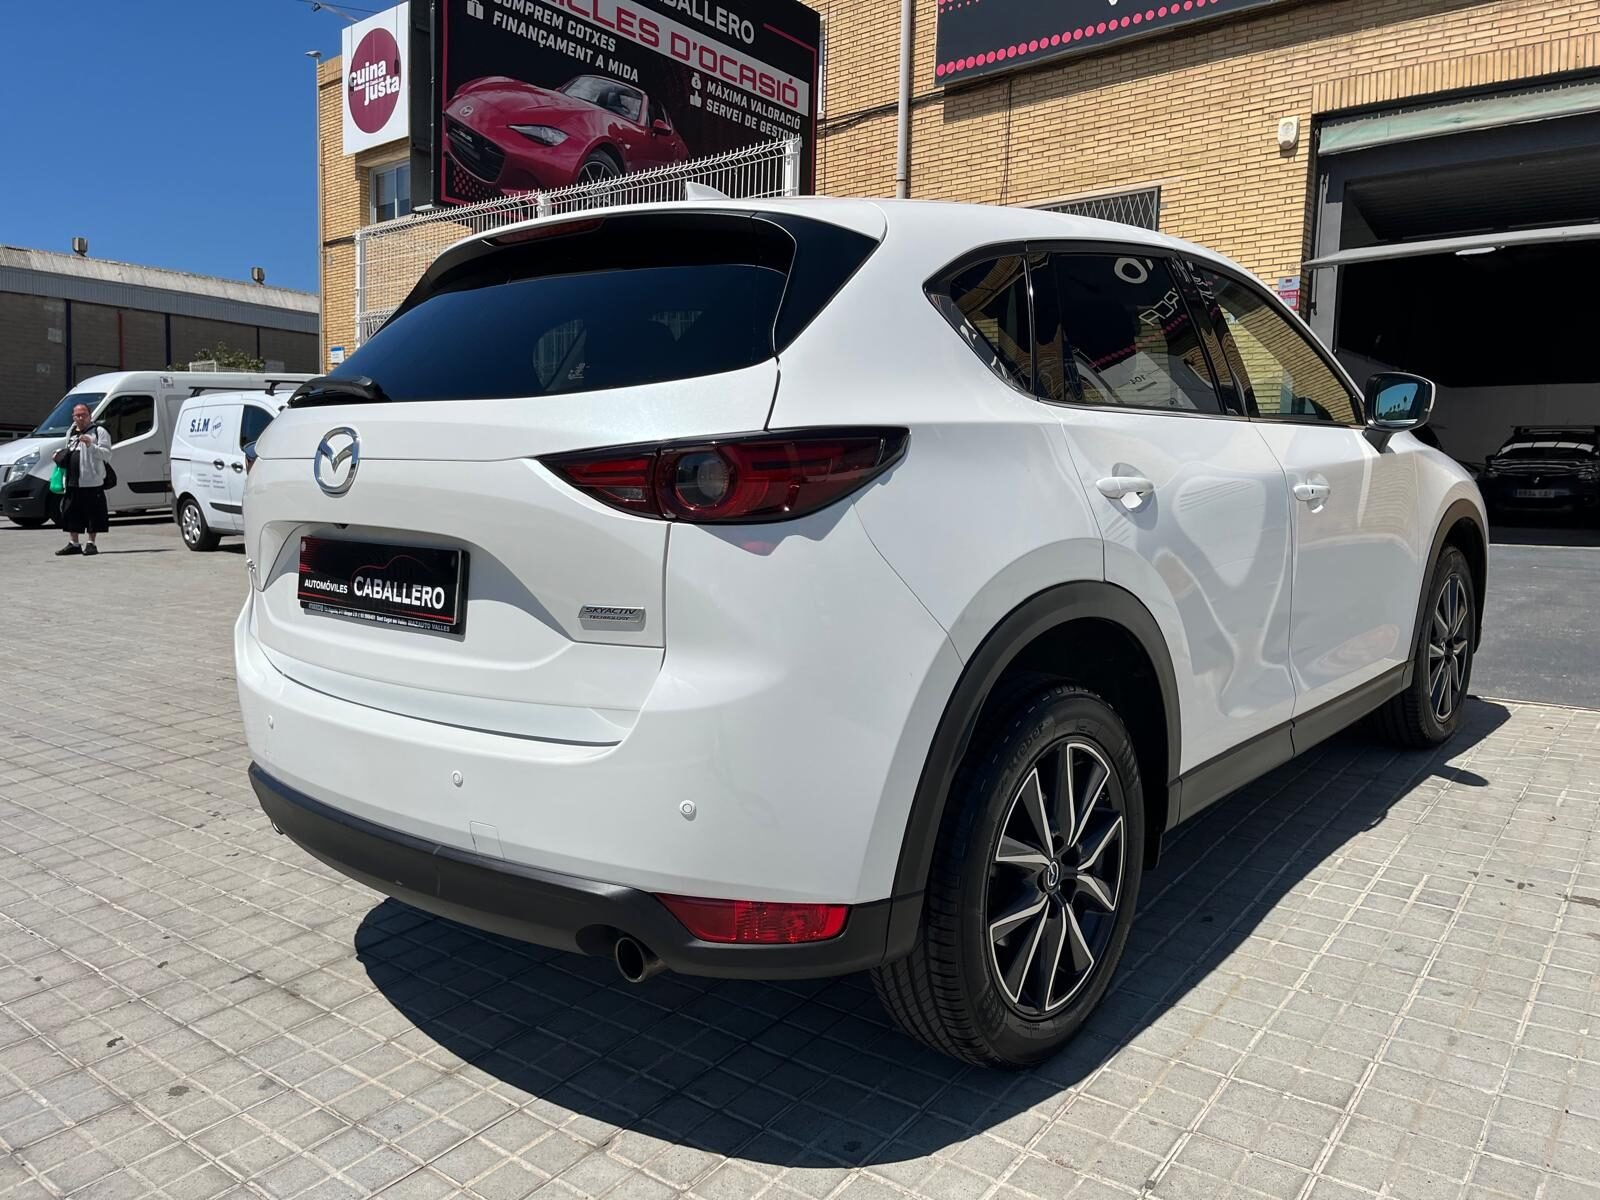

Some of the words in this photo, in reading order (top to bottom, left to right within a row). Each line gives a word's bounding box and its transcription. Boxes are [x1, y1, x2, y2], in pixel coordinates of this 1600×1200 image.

[494, 0, 564, 30] OMPREM
[567, 20, 617, 52] COTXES
[493, 10, 594, 63] FINANÇAMENT
[595, 54, 604, 69] A
[608, 58, 639, 83] MIDA
[349, 60, 386, 87] cuina
[670, 31, 799, 109] D'OCASIÓ
[364, 75, 400, 106] justa
[706, 81, 748, 109] MÀXIMA
[750, 99, 801, 130] VALORACIÓ
[706, 99, 743, 124] SERVEI
[744, 114, 757, 129] DE
[304, 578, 348, 594] AUTOMÓVILES
[353, 576, 445, 610] CABALLERO
[585, 606, 637, 615] SKYACTIV
